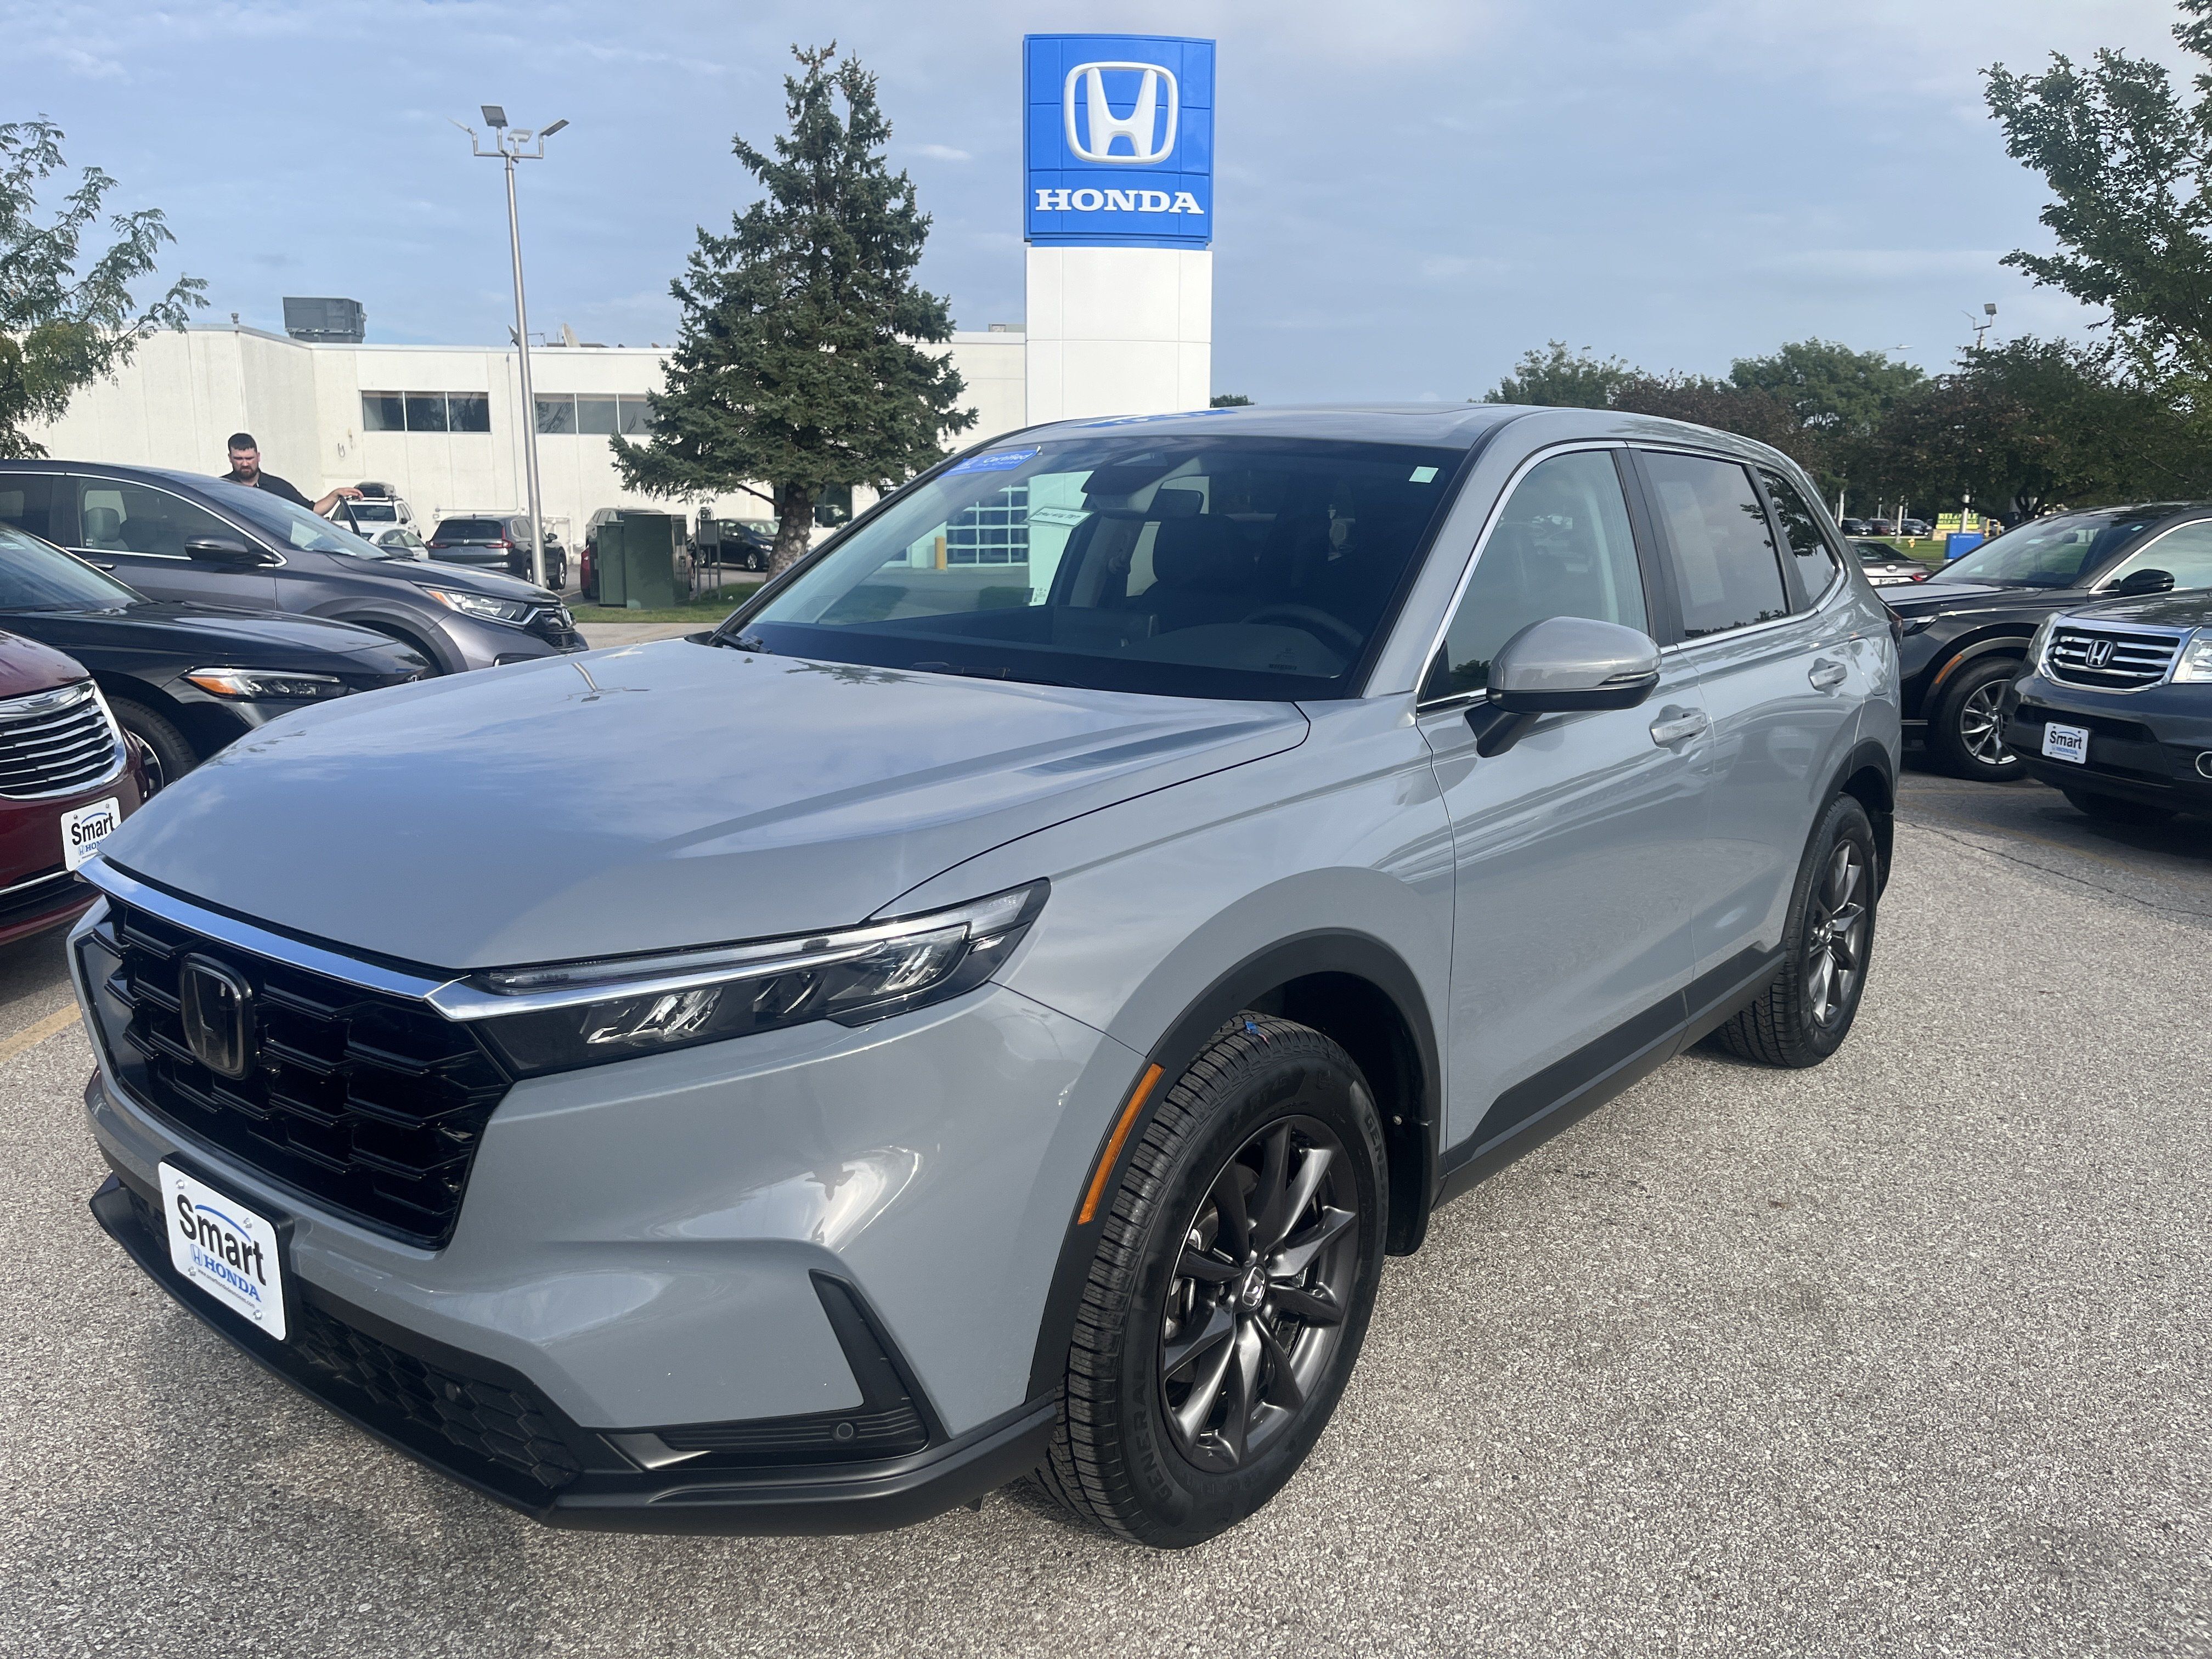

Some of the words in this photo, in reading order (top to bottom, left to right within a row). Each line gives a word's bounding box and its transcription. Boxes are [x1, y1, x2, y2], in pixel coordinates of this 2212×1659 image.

[1035, 189, 1204, 214] HONDA
[983, 453, 1034, 464] Certified
[2050, 731, 2082, 749] Smart
[71, 812, 115, 845] Smart
[177, 1194, 267, 1286] Smart
[204, 1254, 262, 1302] HONDA
[1132, 1357, 1173, 1502] GENERAL
